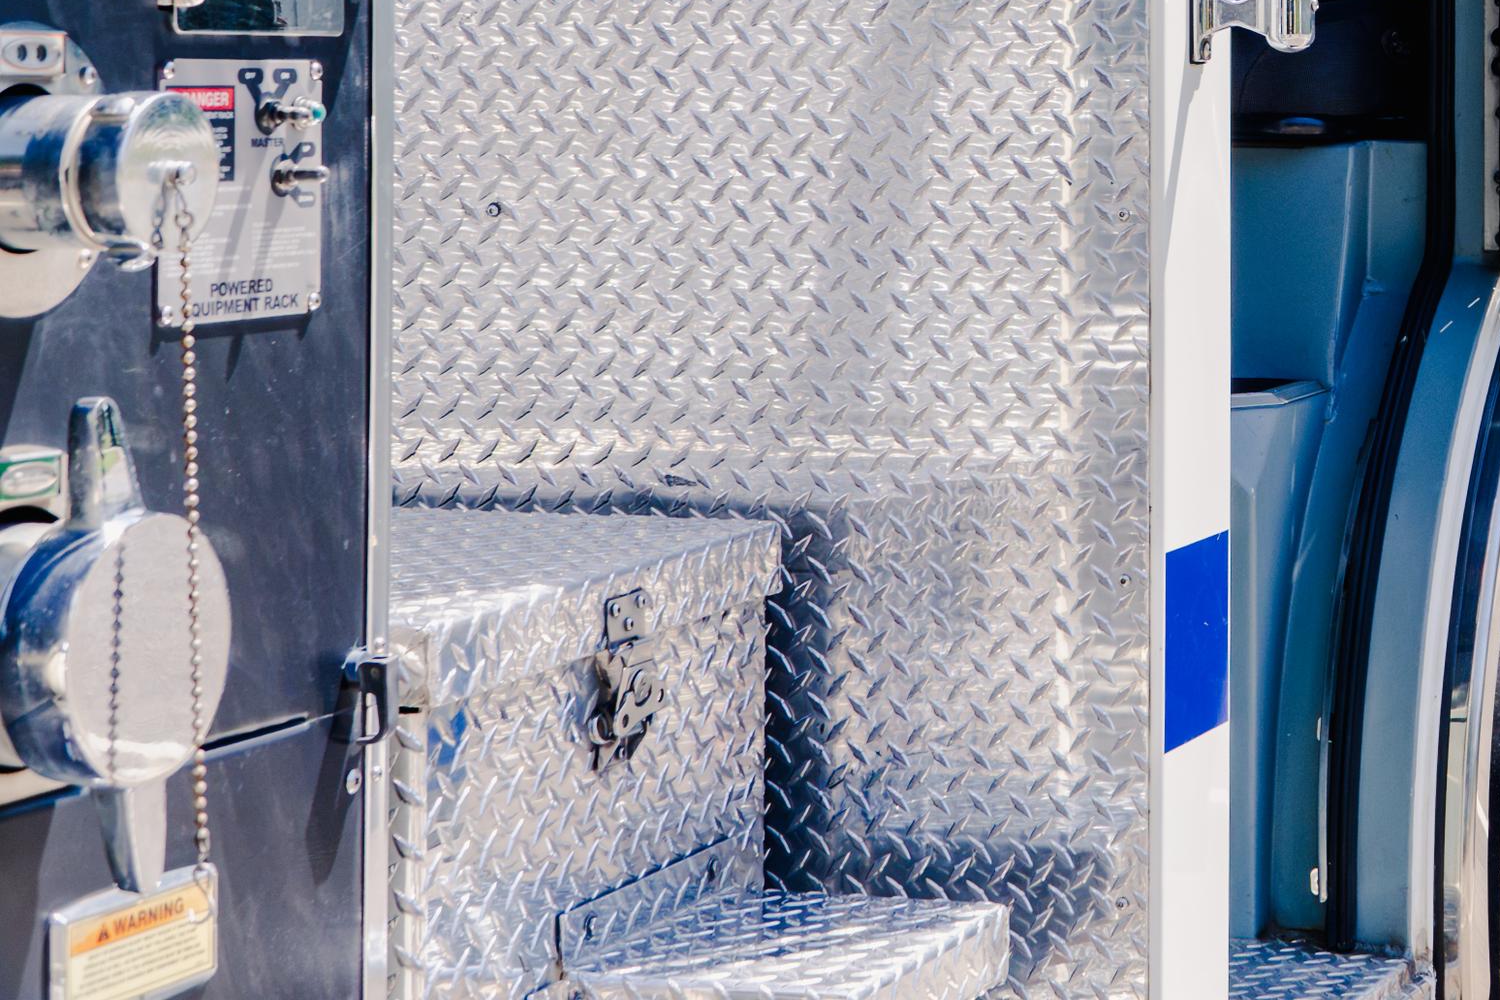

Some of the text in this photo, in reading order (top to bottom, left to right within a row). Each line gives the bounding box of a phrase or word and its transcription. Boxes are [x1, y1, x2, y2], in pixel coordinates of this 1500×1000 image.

[210, 278, 273, 297] POWERED
[190, 294, 299, 318] QUIPMENT RACK
[113, 897, 184, 935] WARNING
